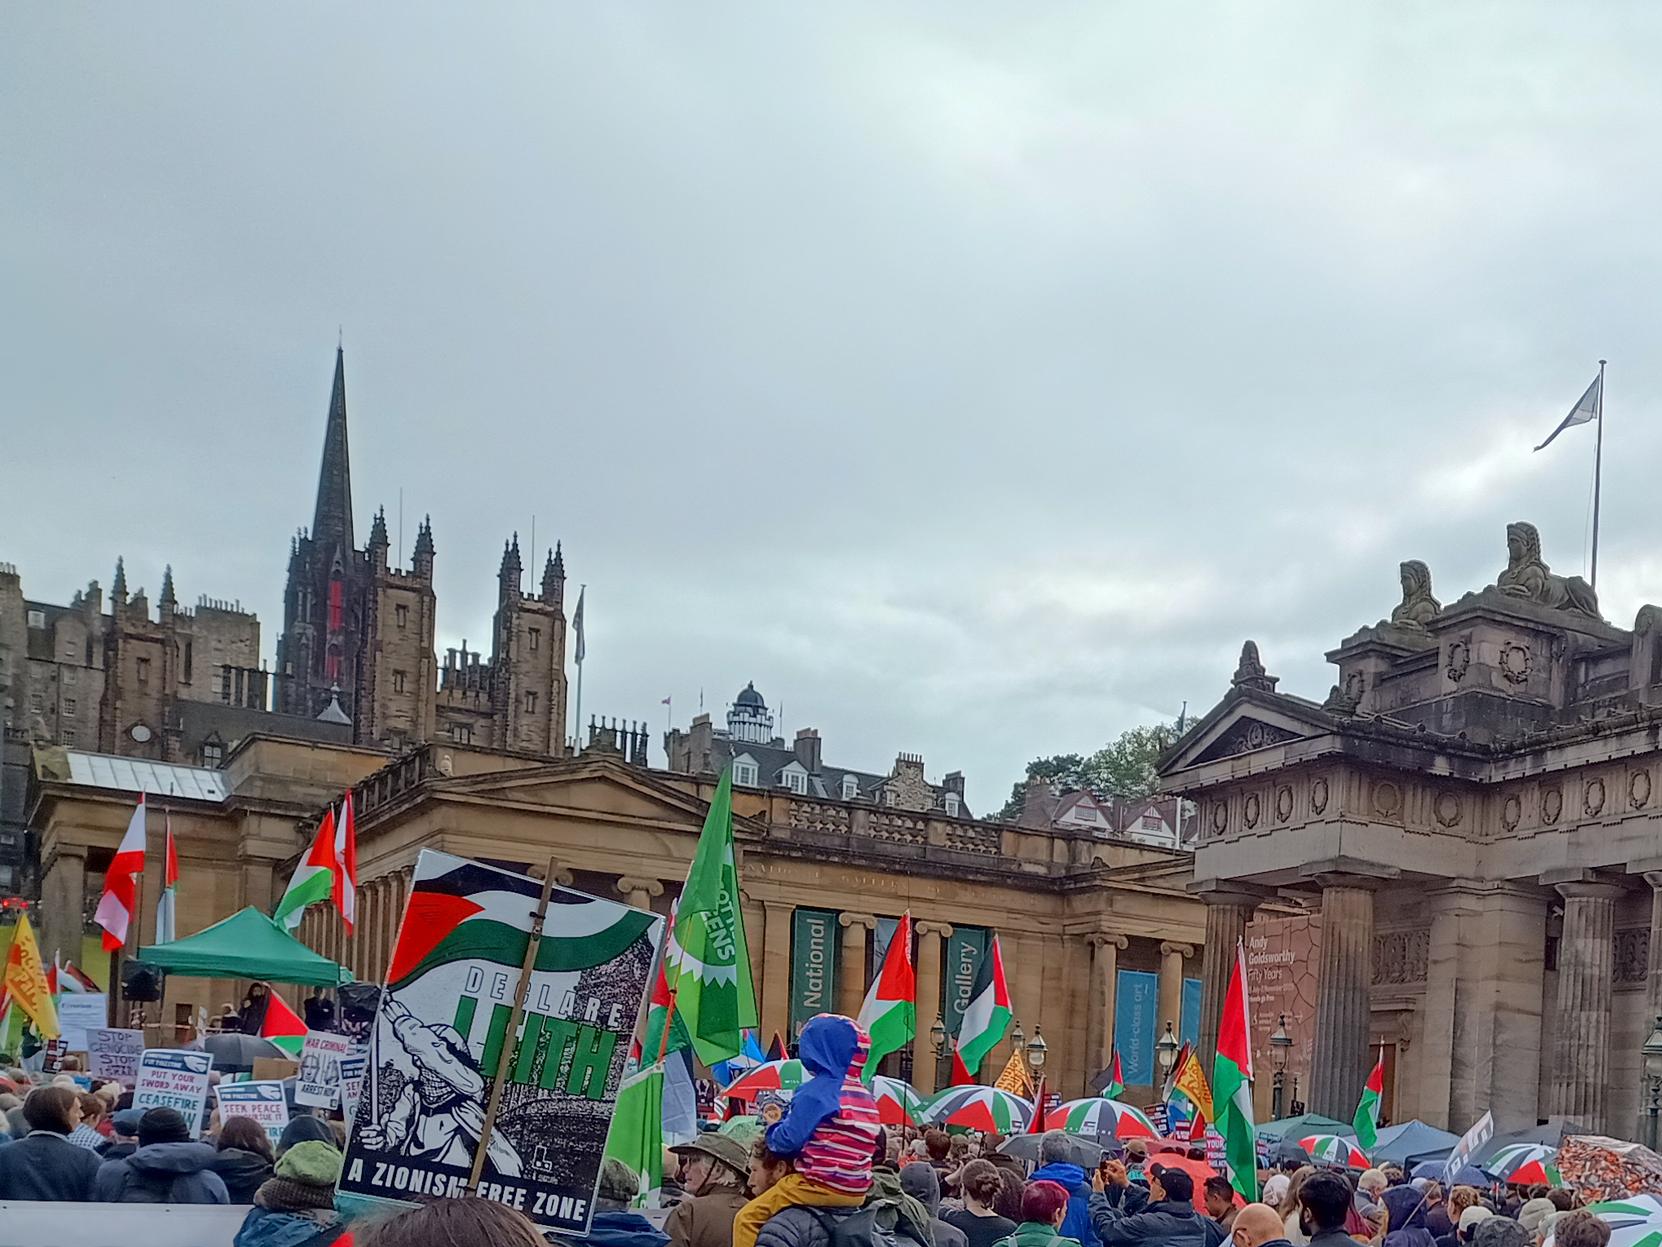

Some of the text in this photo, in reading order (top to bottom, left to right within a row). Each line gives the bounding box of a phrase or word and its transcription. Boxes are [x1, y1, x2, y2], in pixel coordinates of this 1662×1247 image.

[1249, 937, 1268, 949] Andy
[804, 918, 825, 1008] National
[1248, 951, 1295, 965] Goldsworthy
[953, 941, 977, 1014] Gallery
[1264, 968, 1282, 980] Years
[464, 966, 624, 1027] DECLARE
[98, 1031, 132, 1041] STOP
[1128, 984, 1142, 1074] World-class art
[89, 1043, 143, 1055] GENOCIDE
[453, 995, 617, 1100] LEITH
[100, 1055, 136, 1065] STOP
[151, 1071, 195, 1083] PUT YOUR
[141, 1079, 202, 1094] SWORD AWAY
[138, 1093, 199, 1110] CEASEFIRE
[224, 1104, 281, 1113] SEEK PEACE
[348, 1158, 586, 1221] A ZIONISM FREE ZONE
